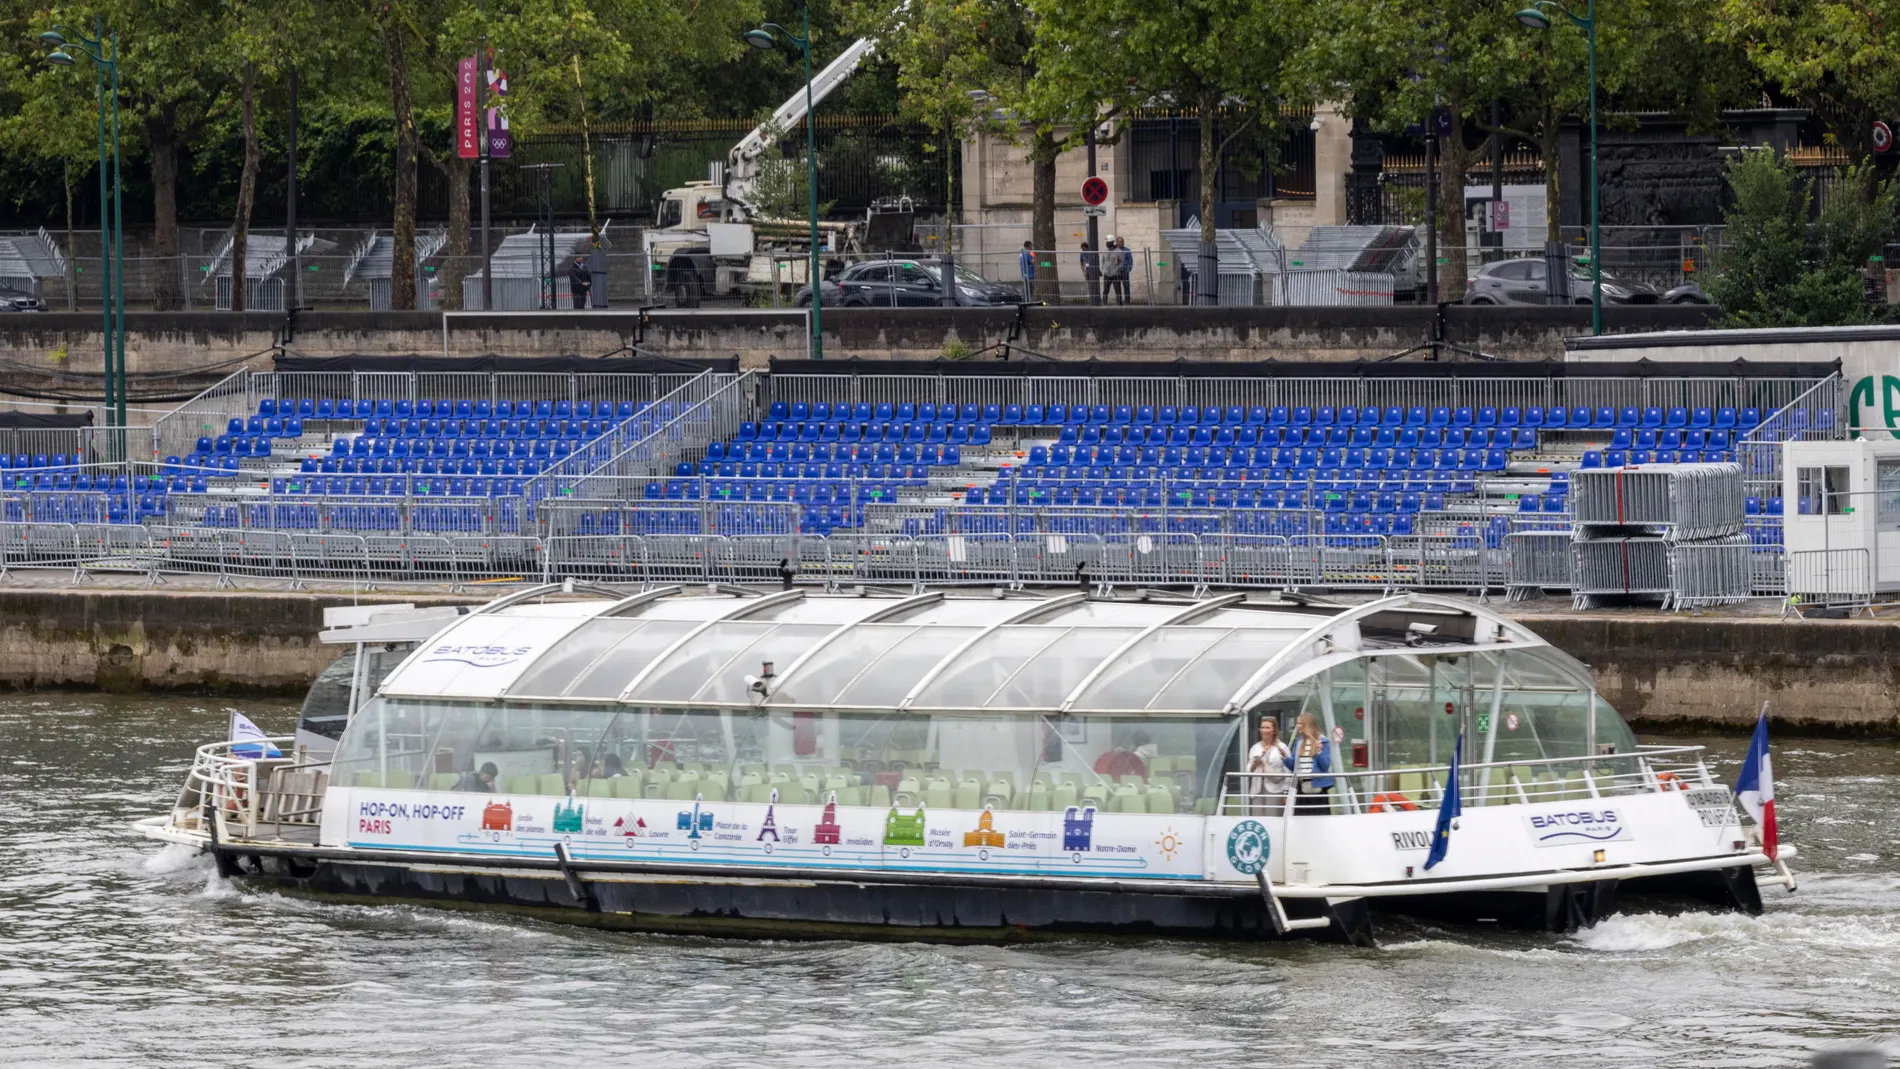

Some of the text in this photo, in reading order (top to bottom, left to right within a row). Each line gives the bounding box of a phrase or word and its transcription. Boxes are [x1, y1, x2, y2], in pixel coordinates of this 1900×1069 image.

[464, 60, 472, 148] PARIS 202
[433, 645, 532, 656] BATOBUS
[359, 801, 465, 821] HOP-ON, HOP-OFF
[1531, 810, 1618, 828] BATOBUS
[359, 819, 391, 834] PARIS
[649, 830, 669, 838] Louvre
[1230, 821, 1269, 840] GREEN
